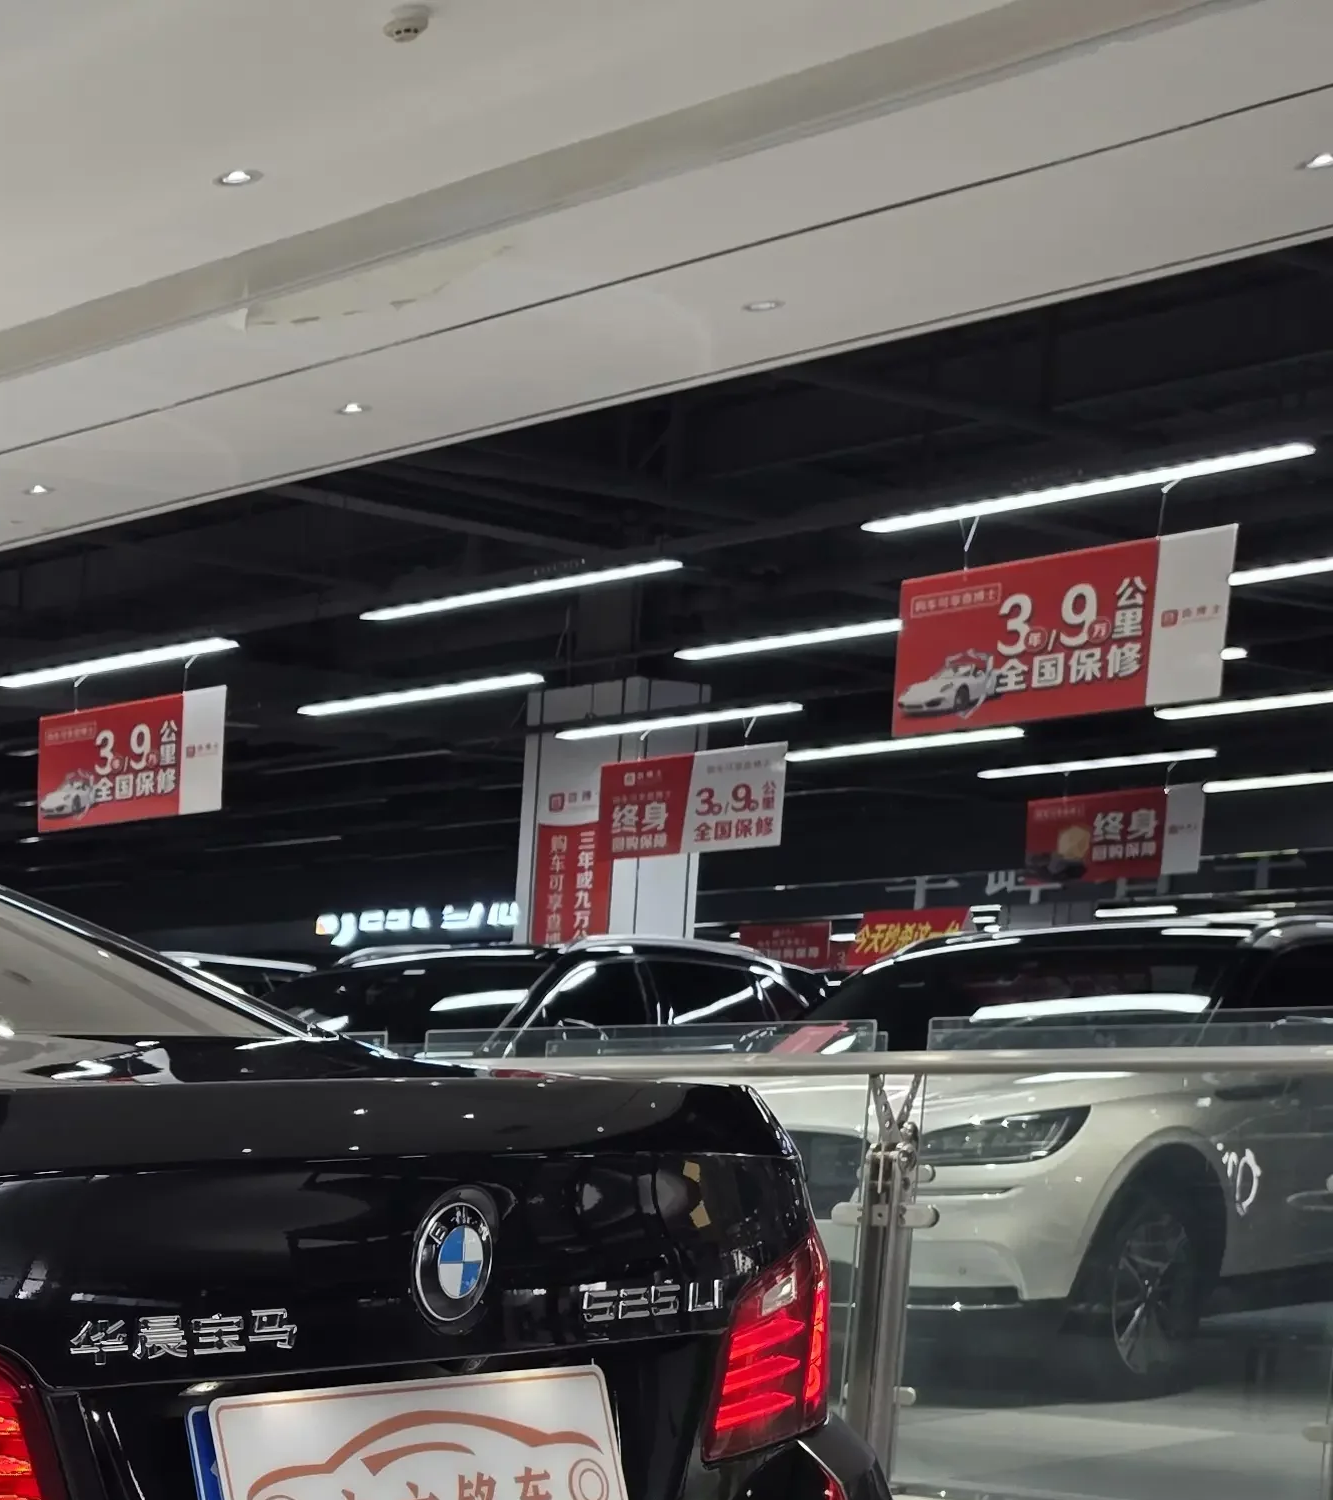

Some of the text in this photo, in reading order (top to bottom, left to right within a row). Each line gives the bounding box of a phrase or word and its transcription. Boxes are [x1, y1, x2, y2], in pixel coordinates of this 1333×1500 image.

[995, 641, 1144, 693] 全国保修
[94, 767, 177, 802] 全国保修
[611, 801, 669, 834] 终身
[693, 815, 775, 842] 全国保修
[1092, 807, 1159, 842] 终身
[69, 1308, 298, 1367] 华晨宝马
